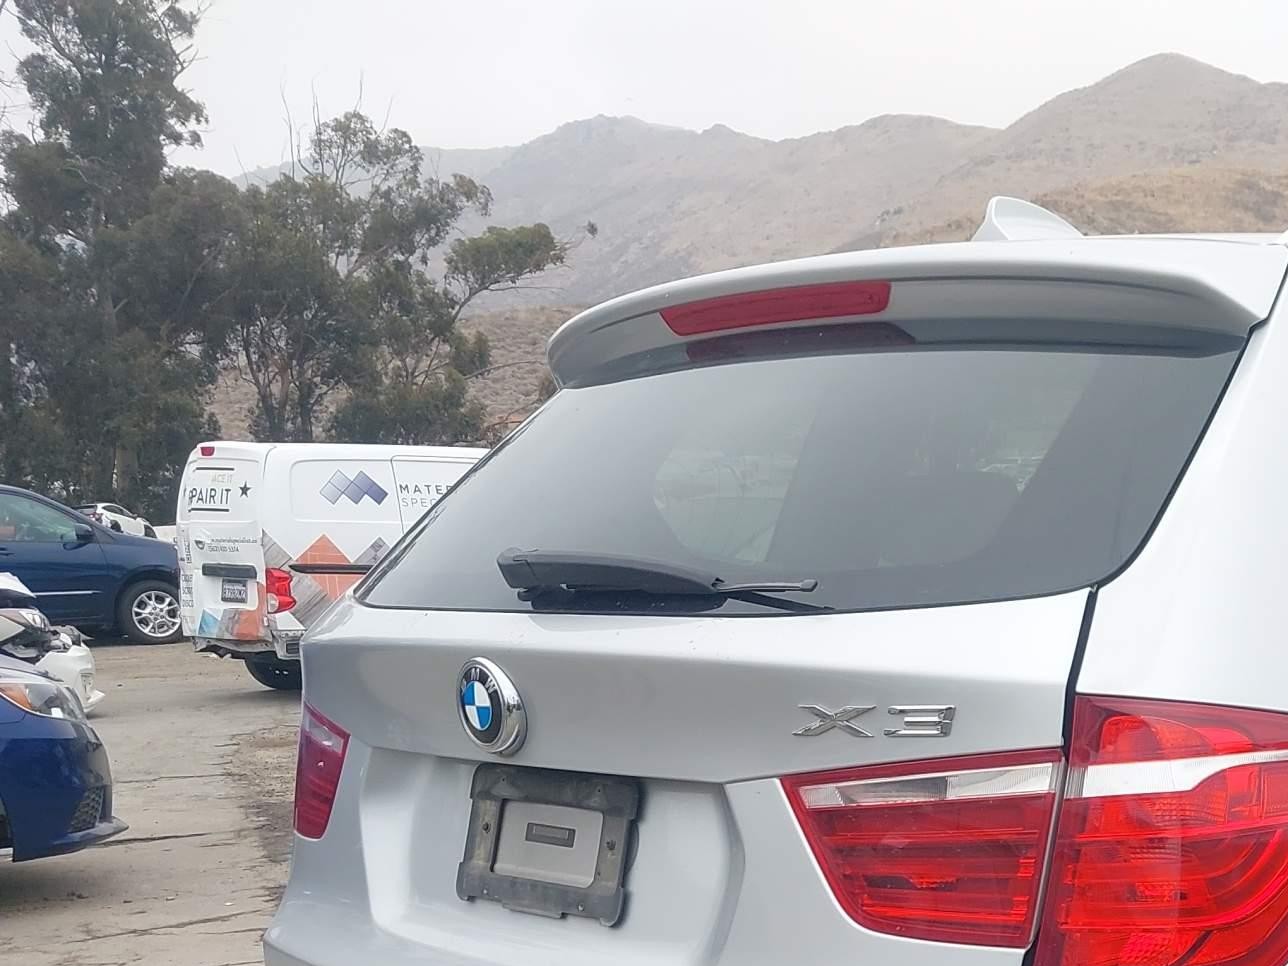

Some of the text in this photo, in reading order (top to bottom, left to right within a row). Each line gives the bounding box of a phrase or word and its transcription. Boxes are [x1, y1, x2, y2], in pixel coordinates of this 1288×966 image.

[219, 488, 231, 505] IT
[460, 667, 498, 696] BMW
[791, 703, 957, 738] X3
